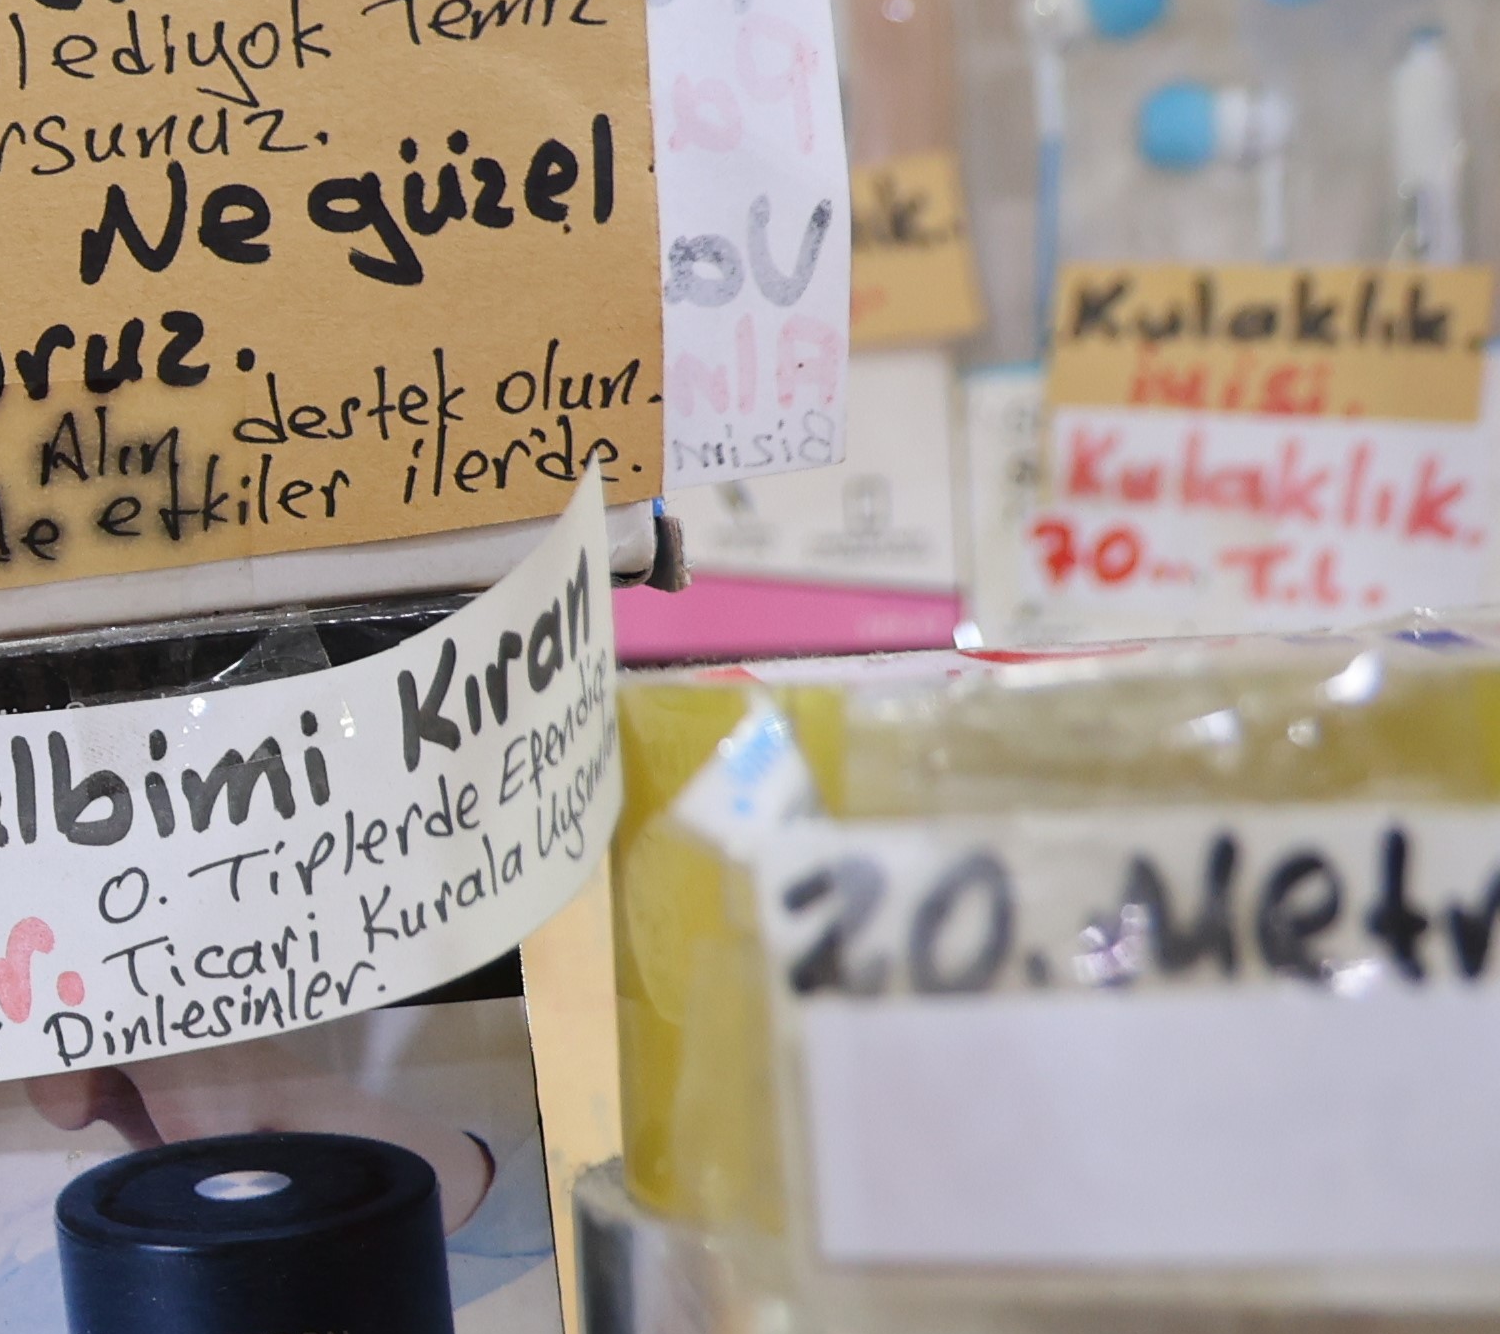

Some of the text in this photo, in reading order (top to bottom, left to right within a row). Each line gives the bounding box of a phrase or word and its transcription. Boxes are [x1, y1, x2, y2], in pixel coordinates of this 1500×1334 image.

[307, 113, 615, 286] güzel
[233, 345, 466, 446] destek
[397, 545, 592, 774] Kıran
[188, 775, 481, 899] Tiplerde
[102, 912, 322, 999] Ticari
[360, 833, 526, 957] Kurala
[42, 959, 388, 1068] Dinlesinler.
